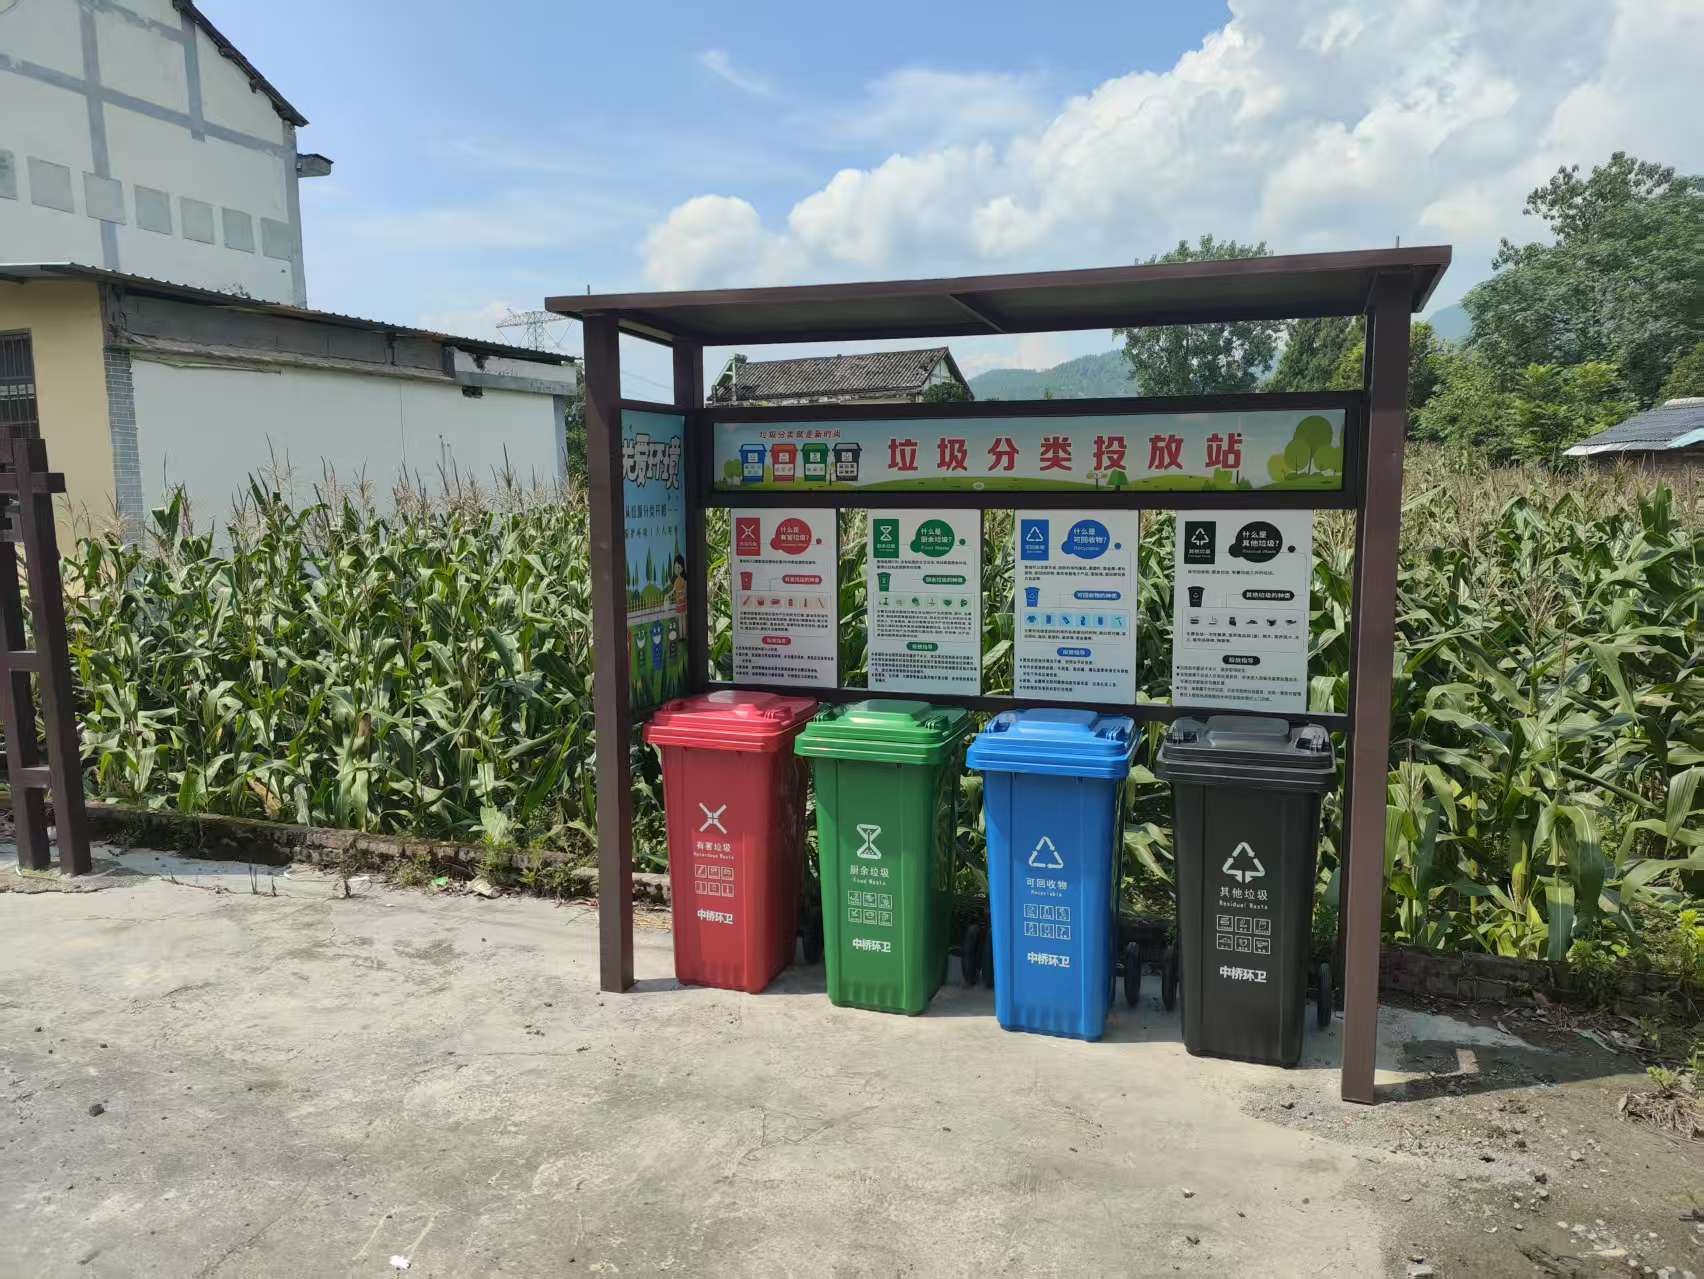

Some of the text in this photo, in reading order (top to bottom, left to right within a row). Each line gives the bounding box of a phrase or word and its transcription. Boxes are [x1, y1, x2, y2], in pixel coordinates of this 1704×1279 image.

[888, 432, 1242, 472] 垃圾分类投放站
[1242, 530, 1267, 538] 什么是
[1026, 878, 1068, 890] 可回收物
[1220, 886, 1268, 901] 其他垃圾
[1027, 951, 1071, 968] 中桥环卫
[1219, 965, 1267, 983] 中桥环卫
